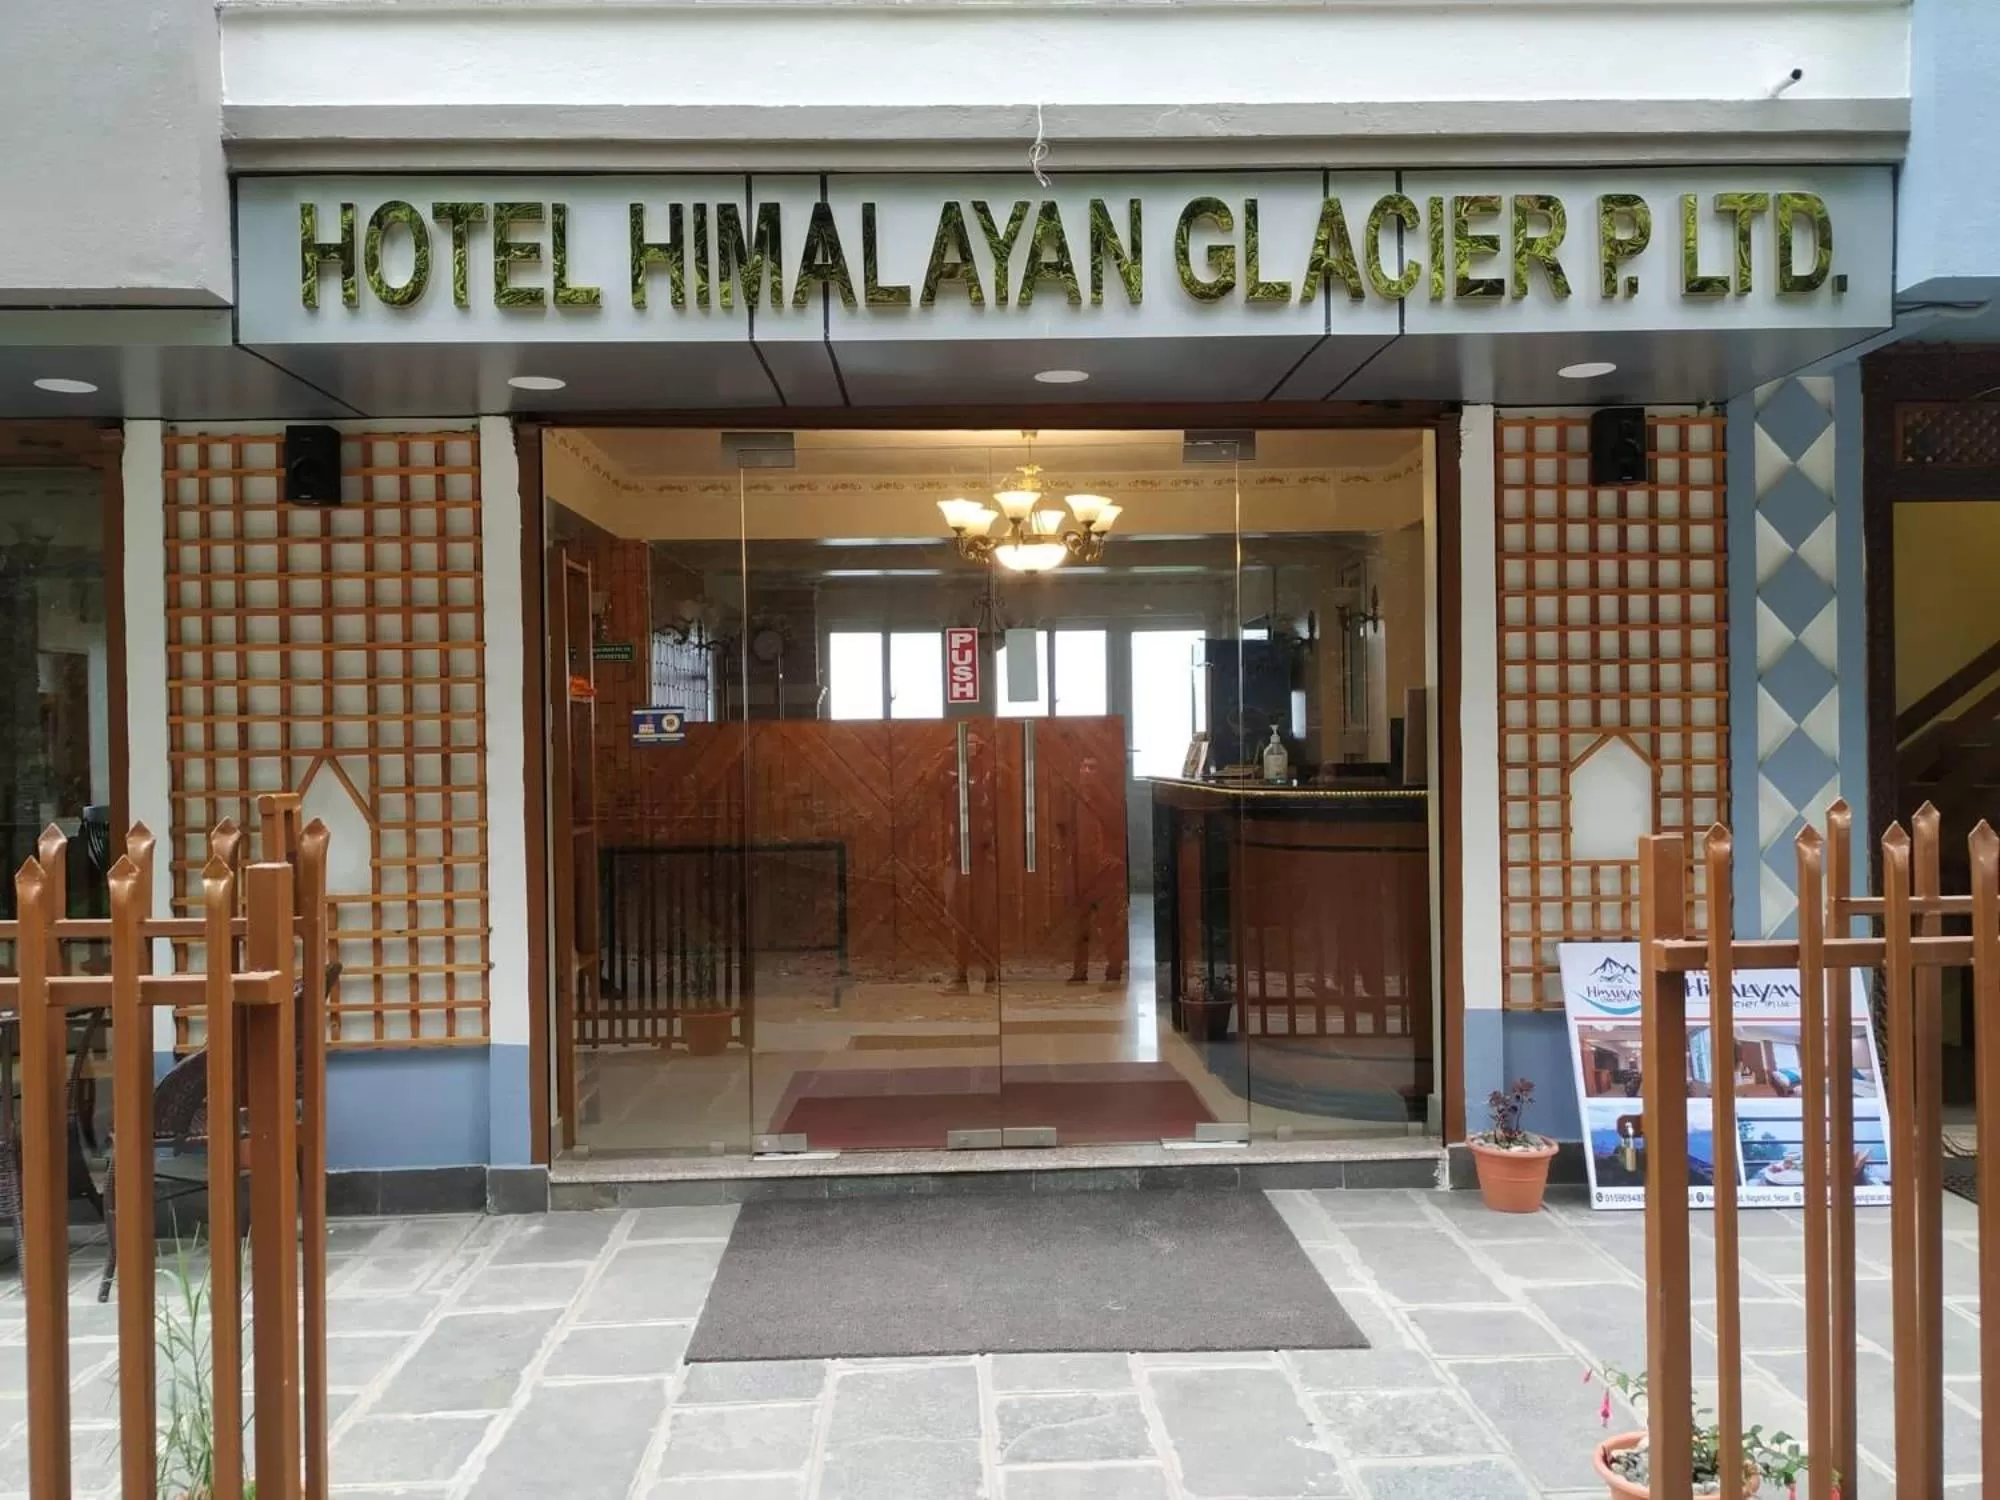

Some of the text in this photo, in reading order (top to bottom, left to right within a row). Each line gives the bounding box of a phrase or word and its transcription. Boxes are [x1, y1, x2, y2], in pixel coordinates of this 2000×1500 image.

[300, 200, 602, 308] HOTEL
[629, 198, 1144, 308] HIMALAYAN
[1175, 194, 1572, 304] GLACIER
[1680, 191, 1848, 298] LTD.
[951, 632, 975, 699] PUSH
